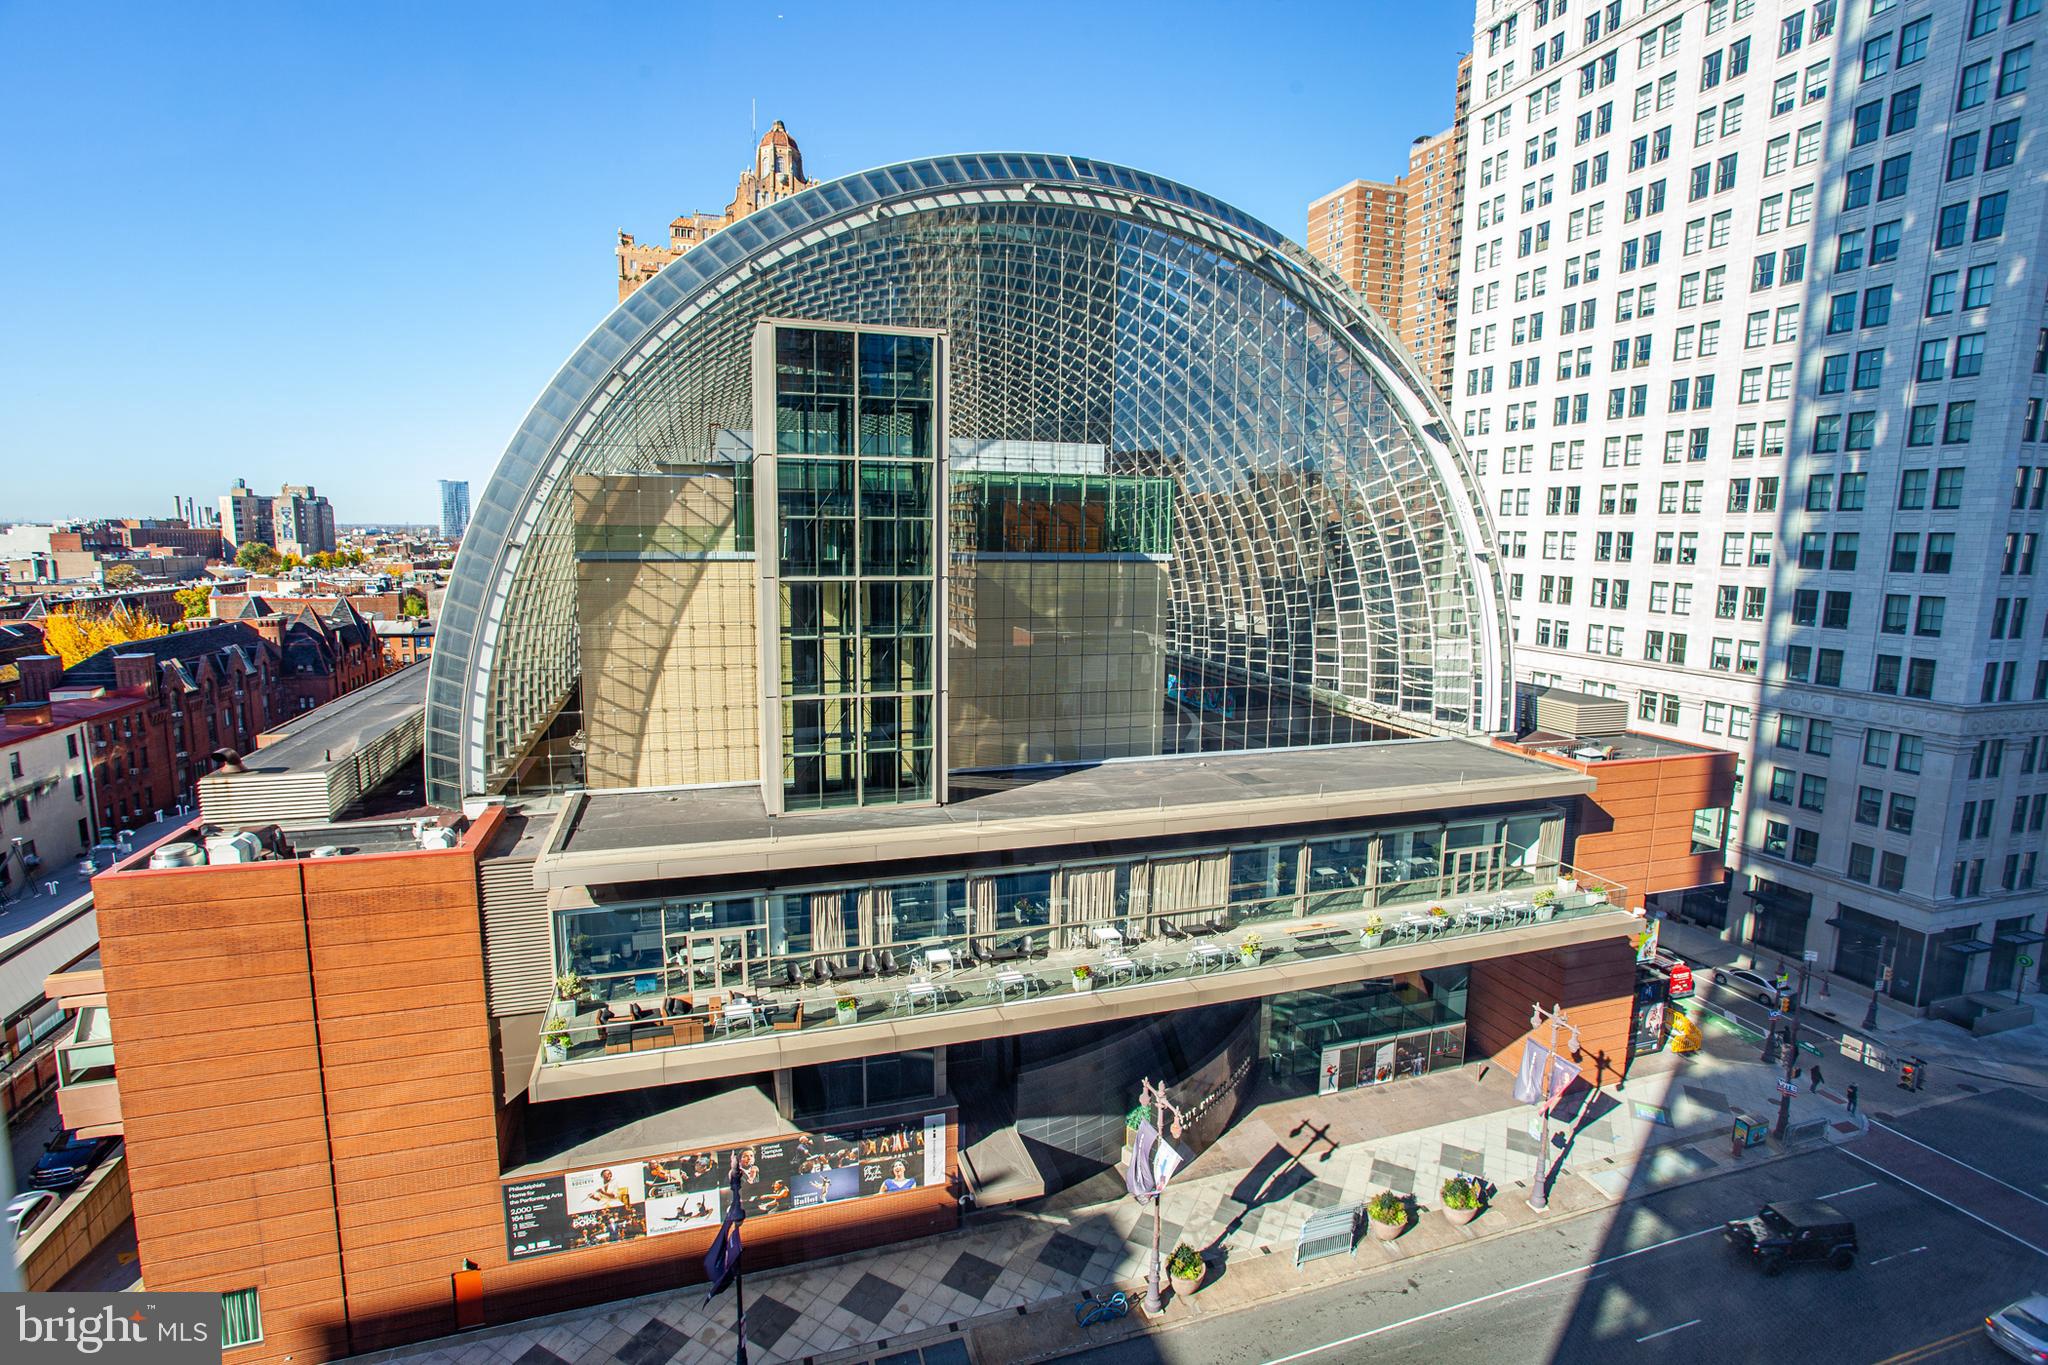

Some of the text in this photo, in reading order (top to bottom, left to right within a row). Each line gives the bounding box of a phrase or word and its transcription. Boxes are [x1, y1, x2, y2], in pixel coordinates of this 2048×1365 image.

[509, 1182, 546, 1192] Philadelphia's
[572, 1179, 594, 1187] SOCIETY
[520, 1194, 551, 1204] Performing
